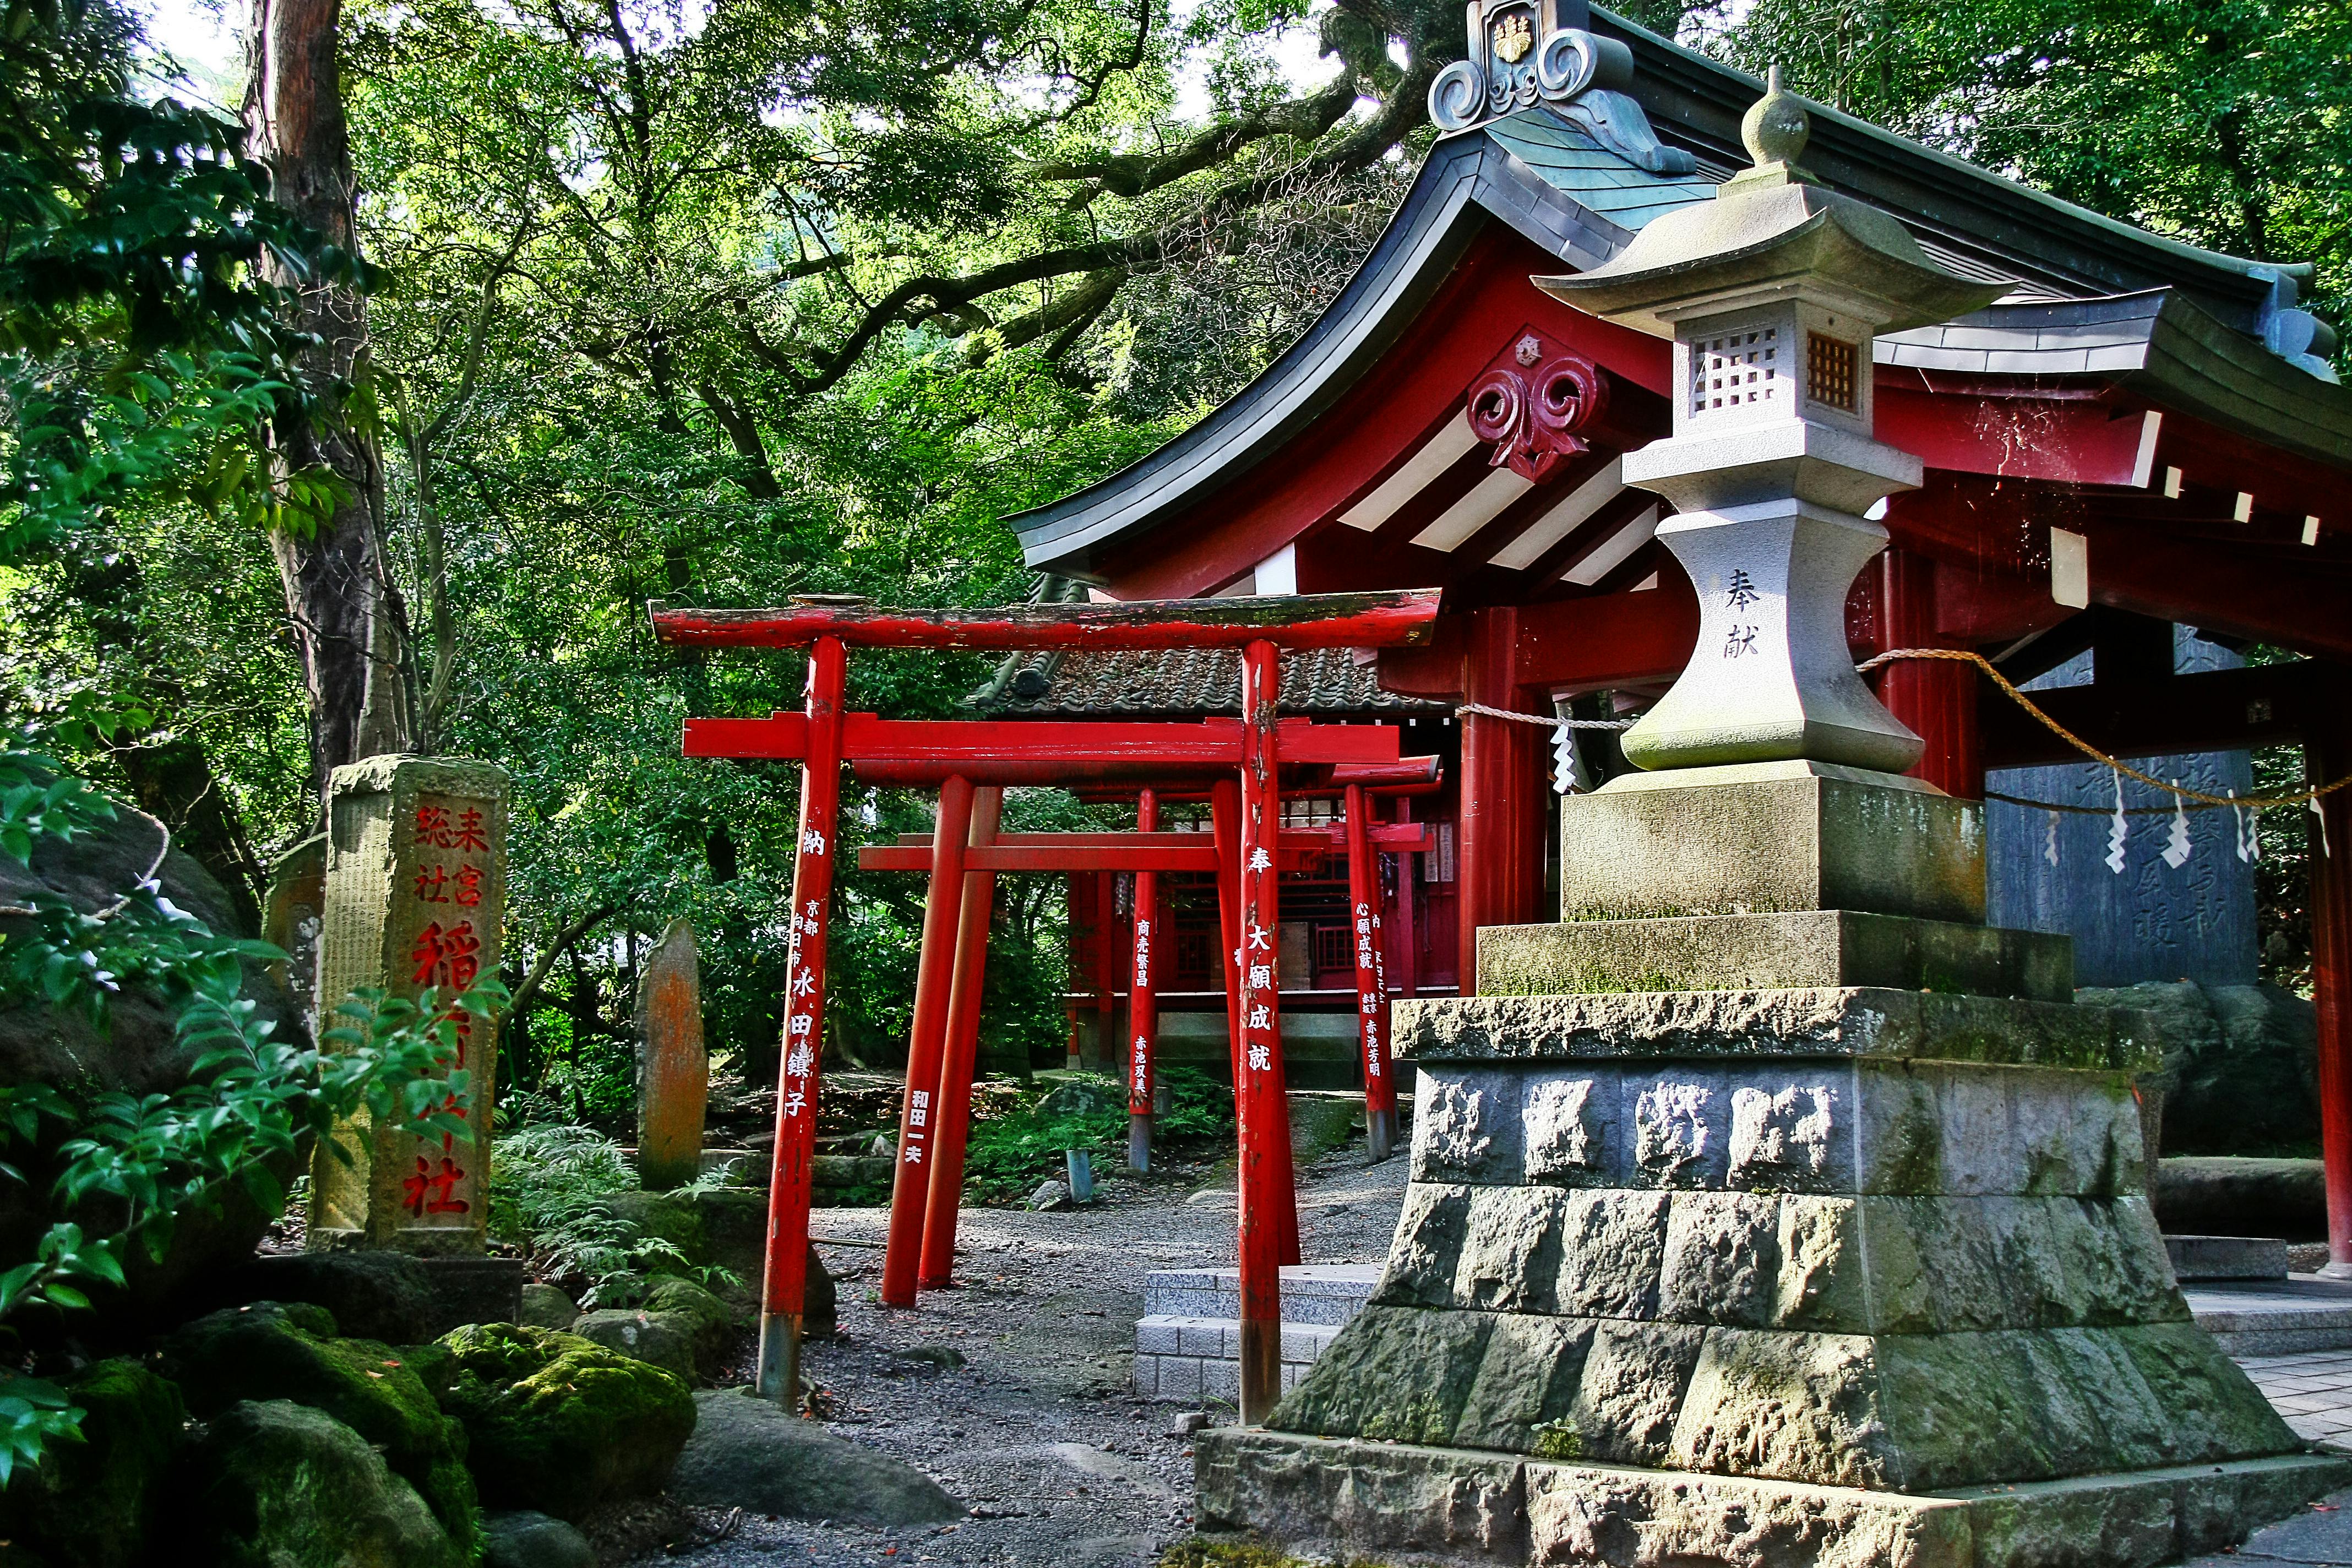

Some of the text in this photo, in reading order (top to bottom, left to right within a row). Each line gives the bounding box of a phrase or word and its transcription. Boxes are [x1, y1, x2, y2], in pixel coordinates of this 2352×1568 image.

[1724, 569, 1761, 659] 奉献
[802, 830, 825, 856] 納
[1248, 847, 1272, 874] 奉
[803, 899, 820, 937] 京都
[1356, 902, 1373, 969] 心願成就
[1136, 919, 1150, 987] 商売繁昌
[1248, 924, 1271, 1071] 大願成就
[402, 919, 481, 1218] 稲社
[1365, 1019, 1380, 1077] 赤池芳明
[905, 1090, 929, 1164] 和田一夫
